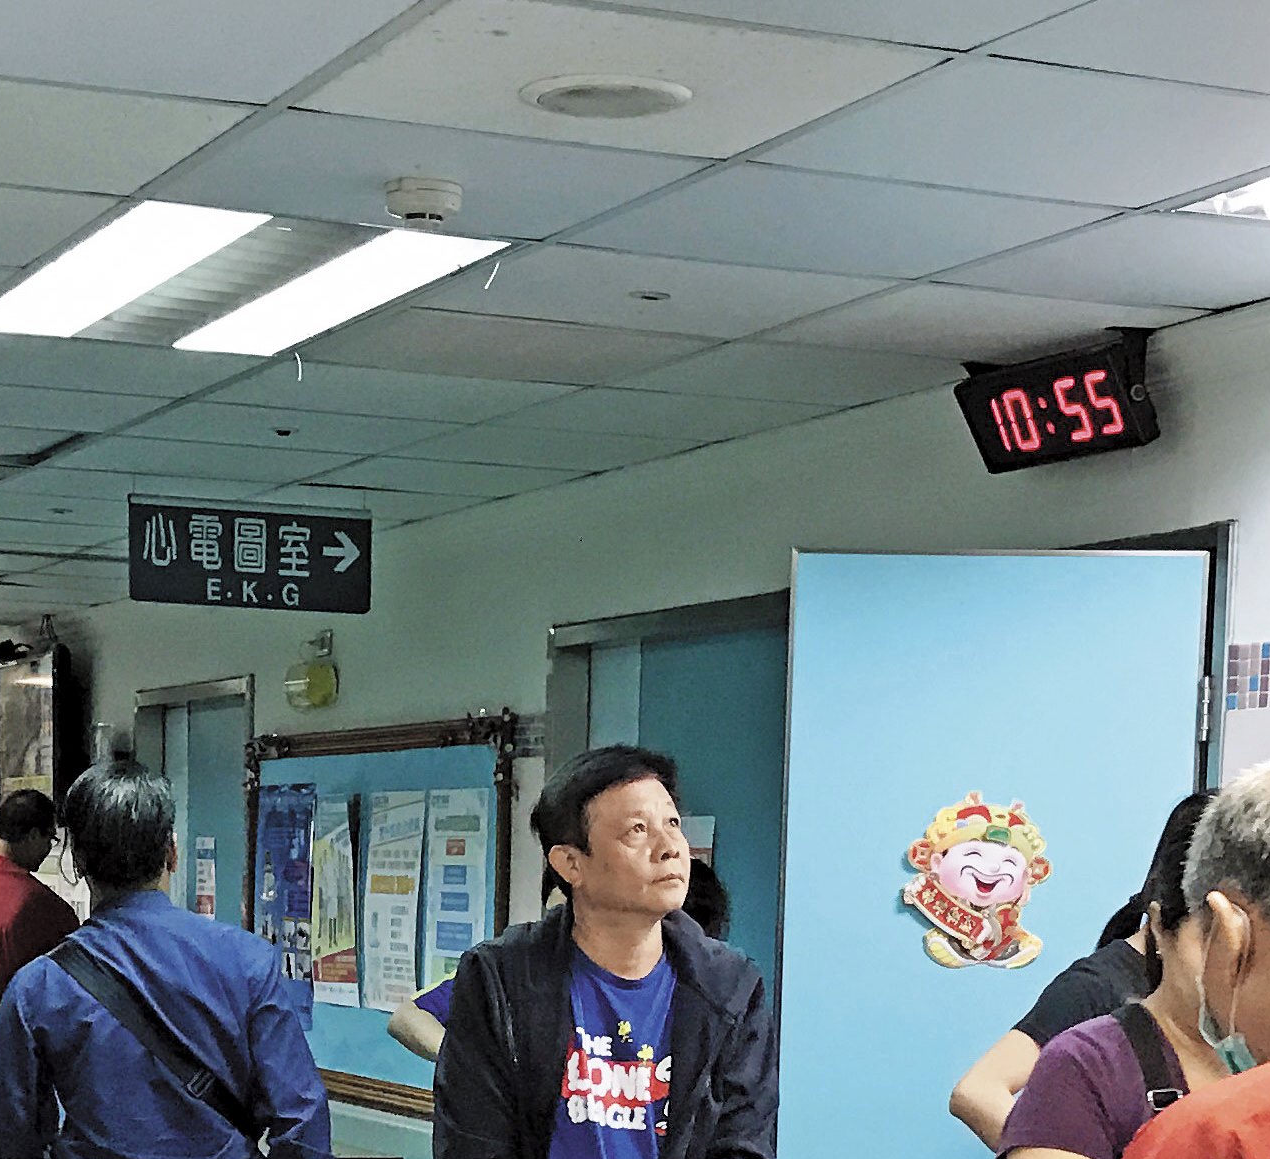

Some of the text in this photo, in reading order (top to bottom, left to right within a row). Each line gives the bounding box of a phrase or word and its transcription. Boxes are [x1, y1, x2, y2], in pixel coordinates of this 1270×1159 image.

[990, 369, 1125, 452] 10:55
[141, 512, 312, 579] 心電圖室
[575, 1026, 613, 1057] THE
[566, 1051, 652, 1102] LONE
